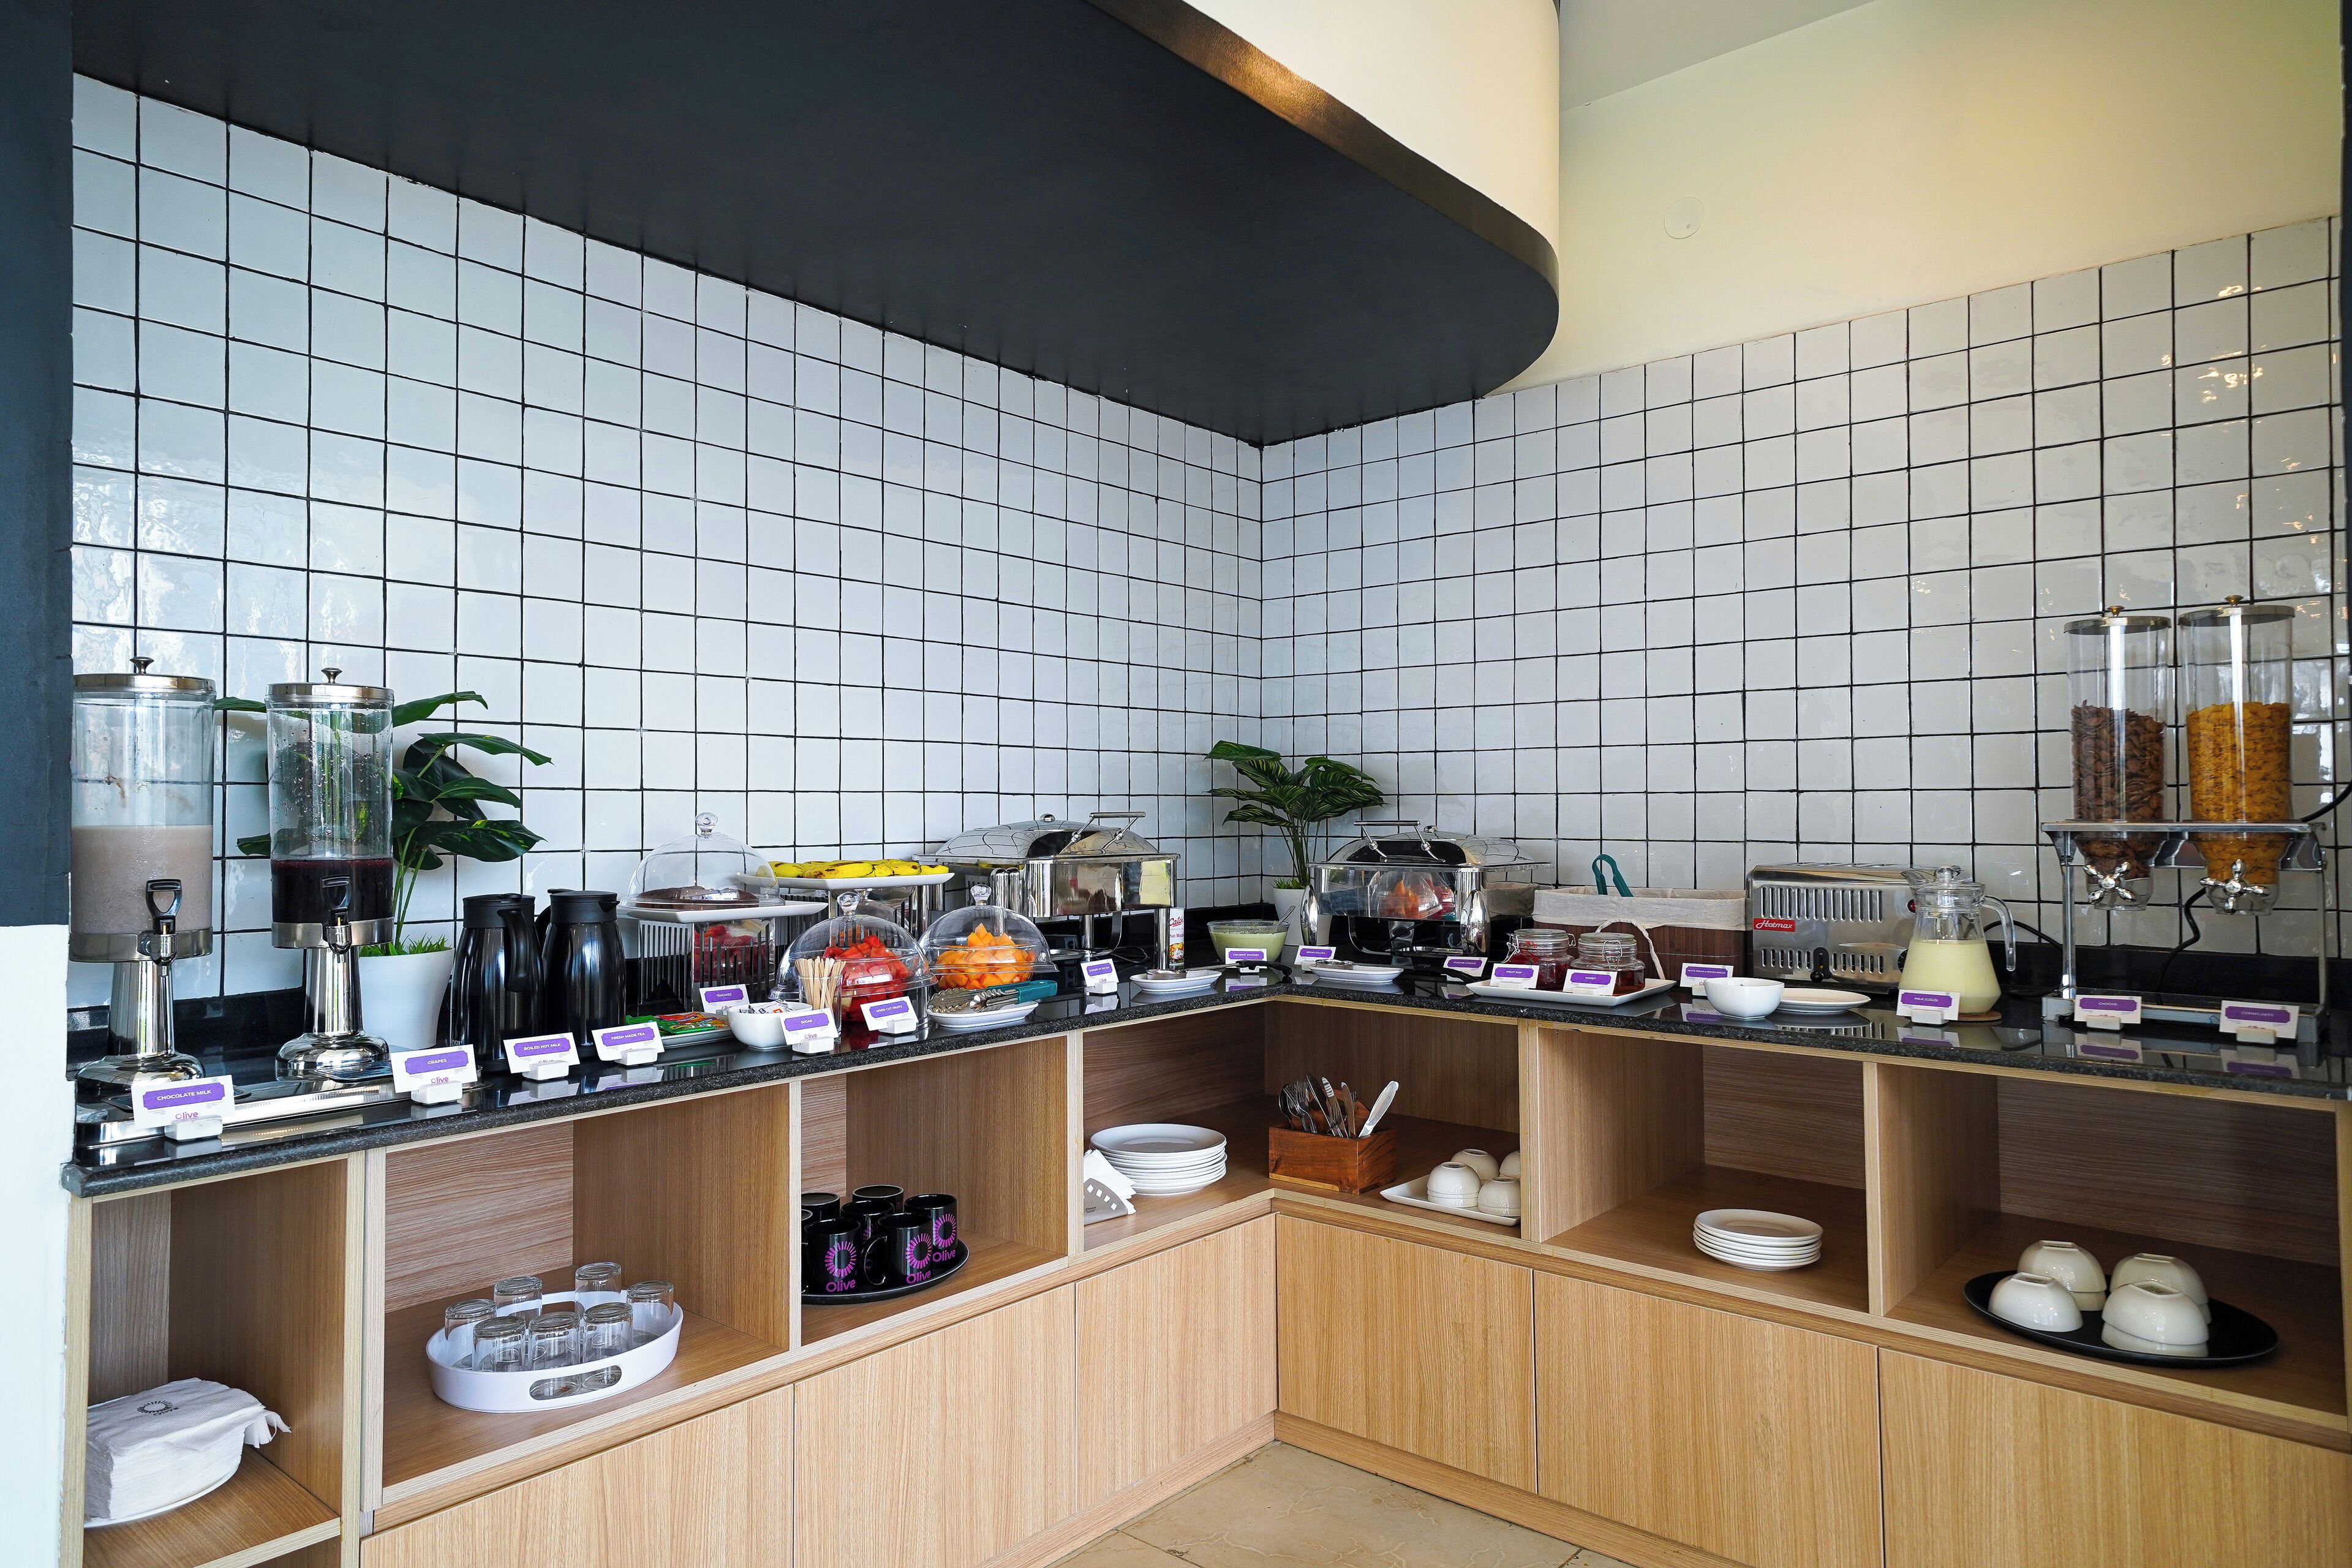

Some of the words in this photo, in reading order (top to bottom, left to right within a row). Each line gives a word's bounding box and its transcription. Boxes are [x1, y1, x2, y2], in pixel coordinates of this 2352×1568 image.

[1755, 919, 1793, 929] Hotmax
[157, 1091, 195, 1101] CHOCOLATE
[932, 1248, 956, 1262] Olive
[906, 1270, 931, 1284] Olive
[826, 1279, 856, 1292] Olive
